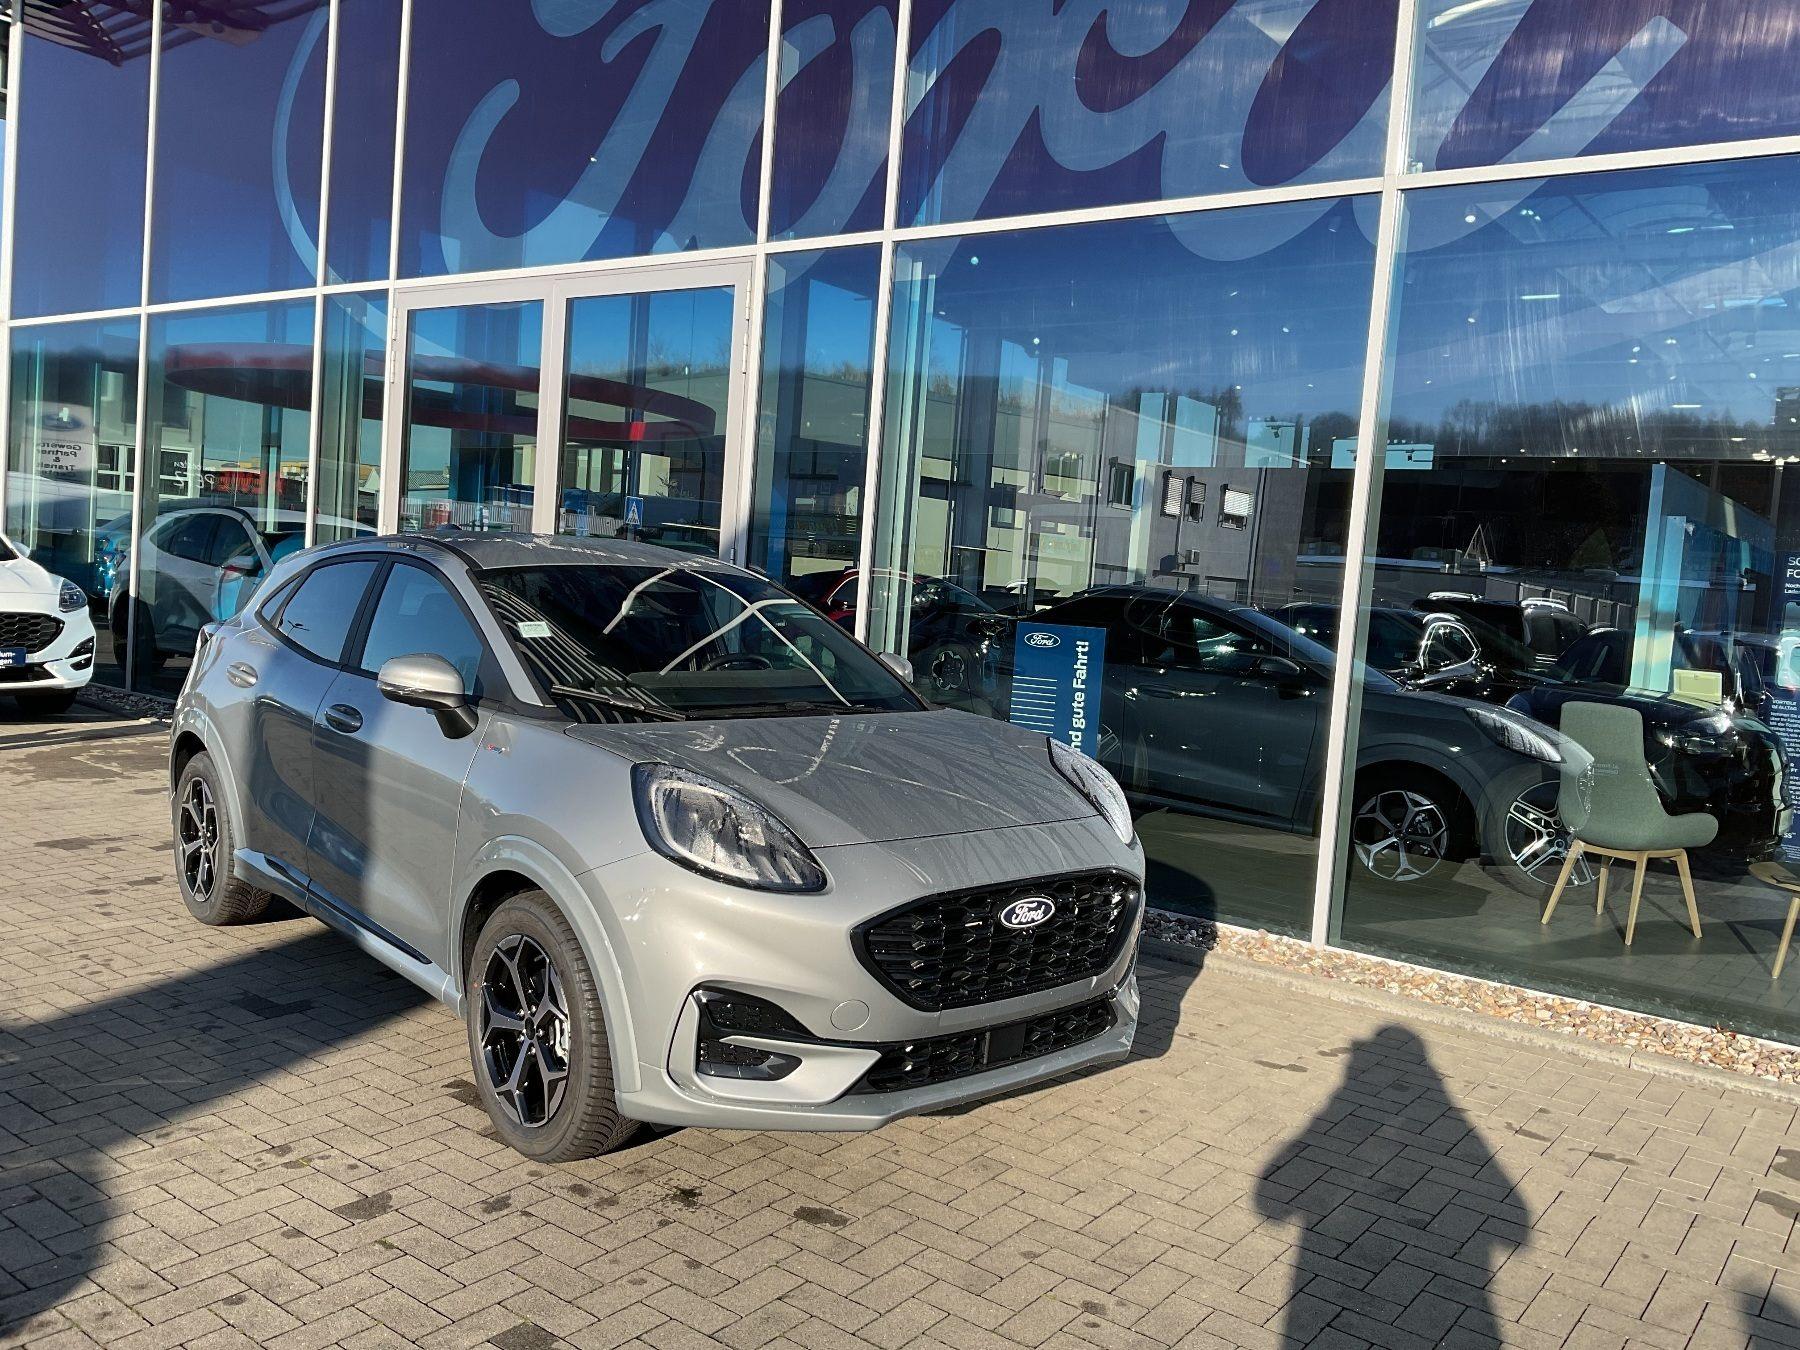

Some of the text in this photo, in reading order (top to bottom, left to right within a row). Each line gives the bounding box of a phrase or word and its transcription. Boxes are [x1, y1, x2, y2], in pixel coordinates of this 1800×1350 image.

[1069, 641, 1089, 751] nd gute Fahrt!
[1012, 902, 1045, 924] Ford
